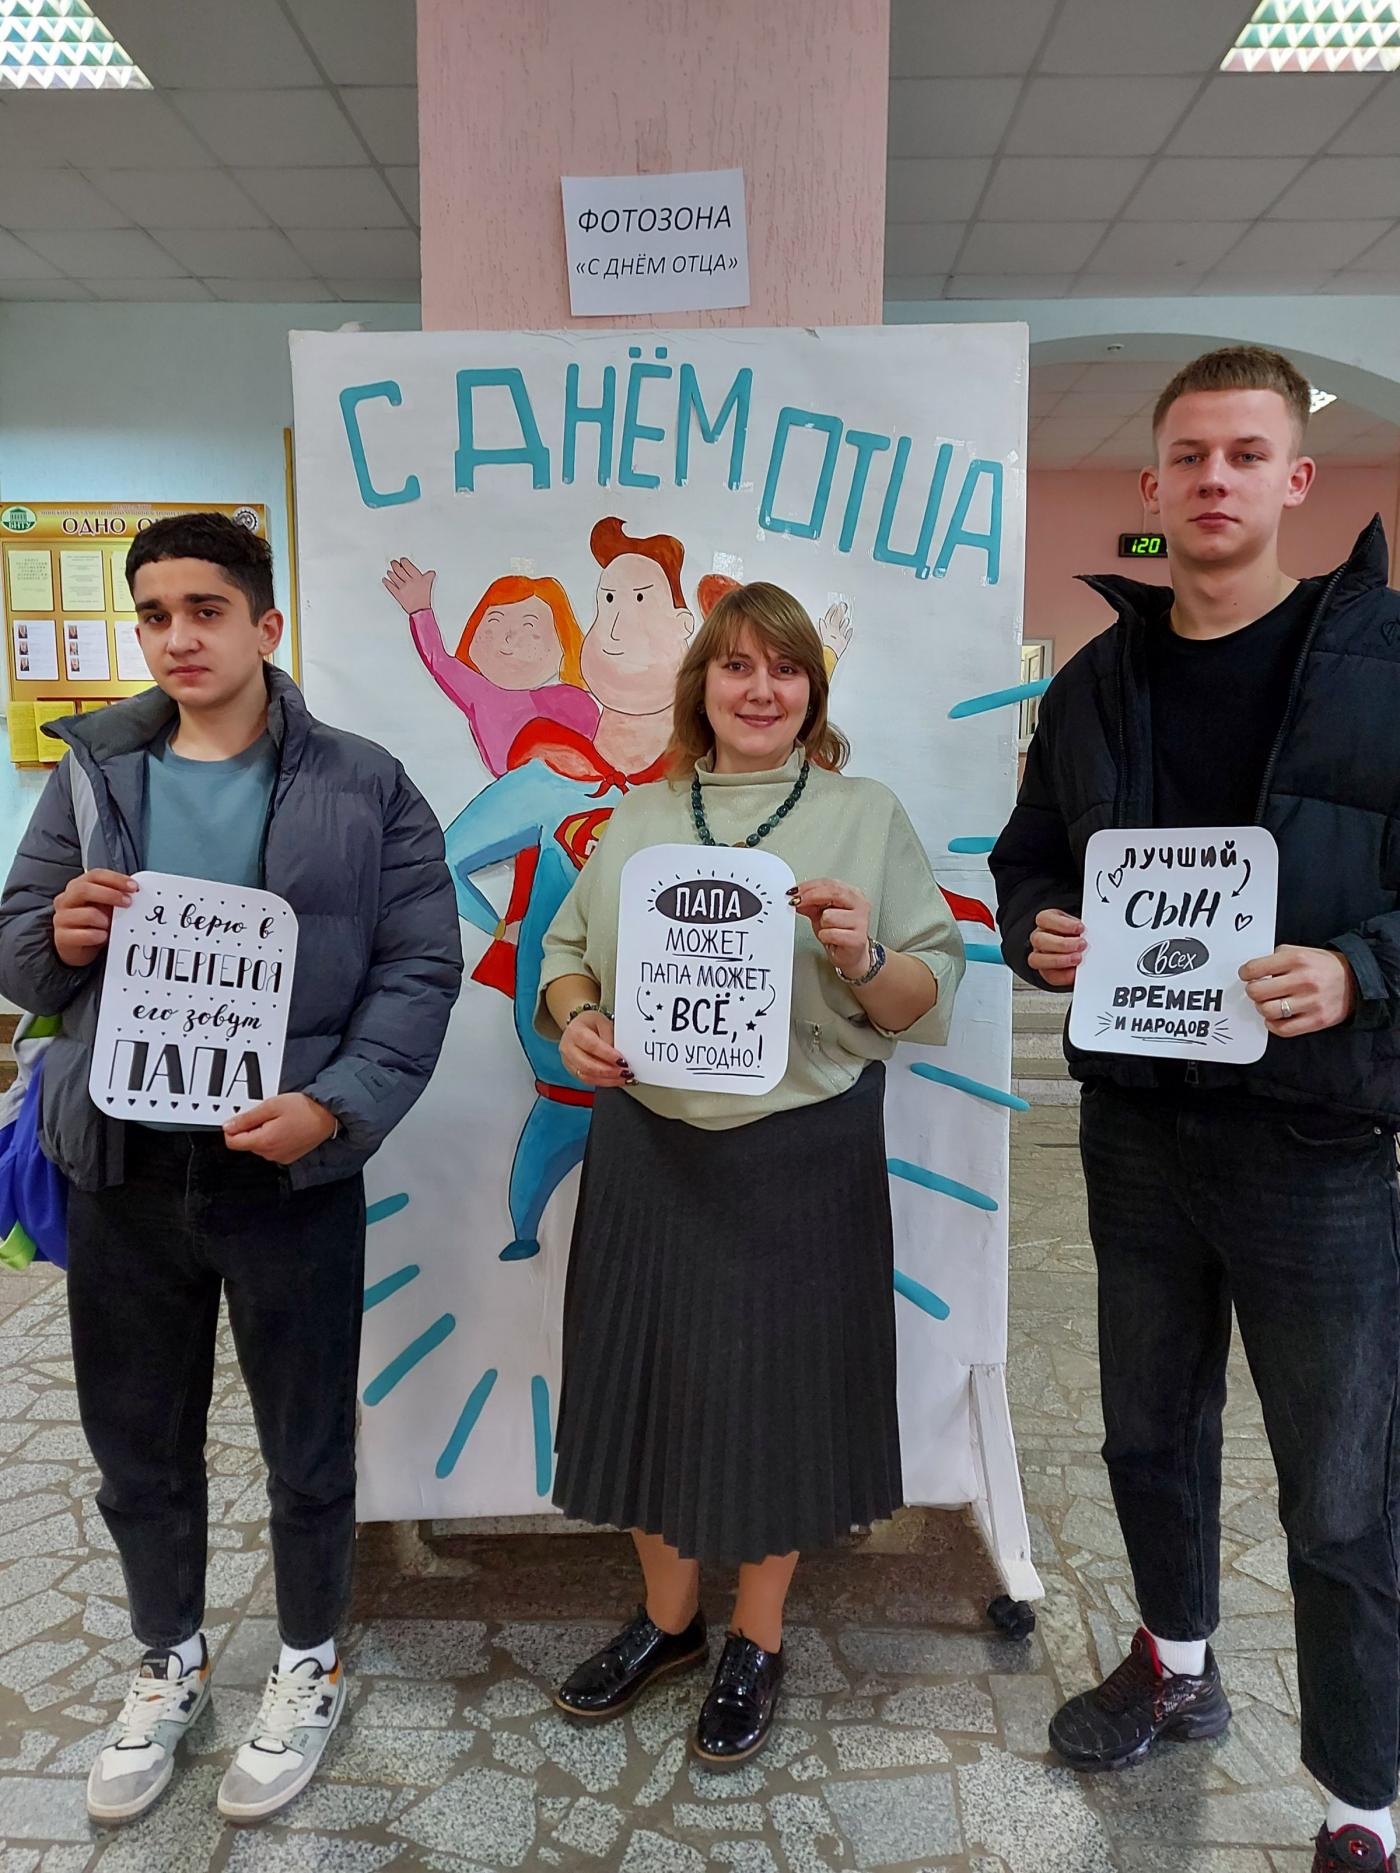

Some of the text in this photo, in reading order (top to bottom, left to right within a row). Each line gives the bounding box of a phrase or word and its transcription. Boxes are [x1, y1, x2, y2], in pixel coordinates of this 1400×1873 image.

[578, 205, 731, 233] ФОТОЗОНА
[576, 253, 738, 279] «С ДНЁМ ОТЦА»
[339, 346, 1004, 584] С ДНЁМ ОТЦА
[62, 517, 126, 535] ОДНО
[1132, 537, 1168, 553] 120
[1120, 840, 1237, 869] ЛУЧШИЙ
[675, 887, 741, 919] ПАПА
[1125, 888, 1221, 929] СЫН
[179, 903, 247, 937] верю
[665, 928, 754, 961] МОЖЕТ,
[126, 943, 282, 993] СУПЕРГЕРОЯ
[640, 962, 771, 991] ПАПА МОЖЕТ
[1112, 985, 1223, 1012] ВРЕМЕН
[132, 1003, 263, 1038] его зовут
[671, 992, 738, 1044] ВСЁ,
[1114, 1016, 1210, 1038] И НАРОДОВ
[644, 1034, 763, 1070] ЧТО УГОДНО!
[108, 1039, 264, 1101] ПАПА
